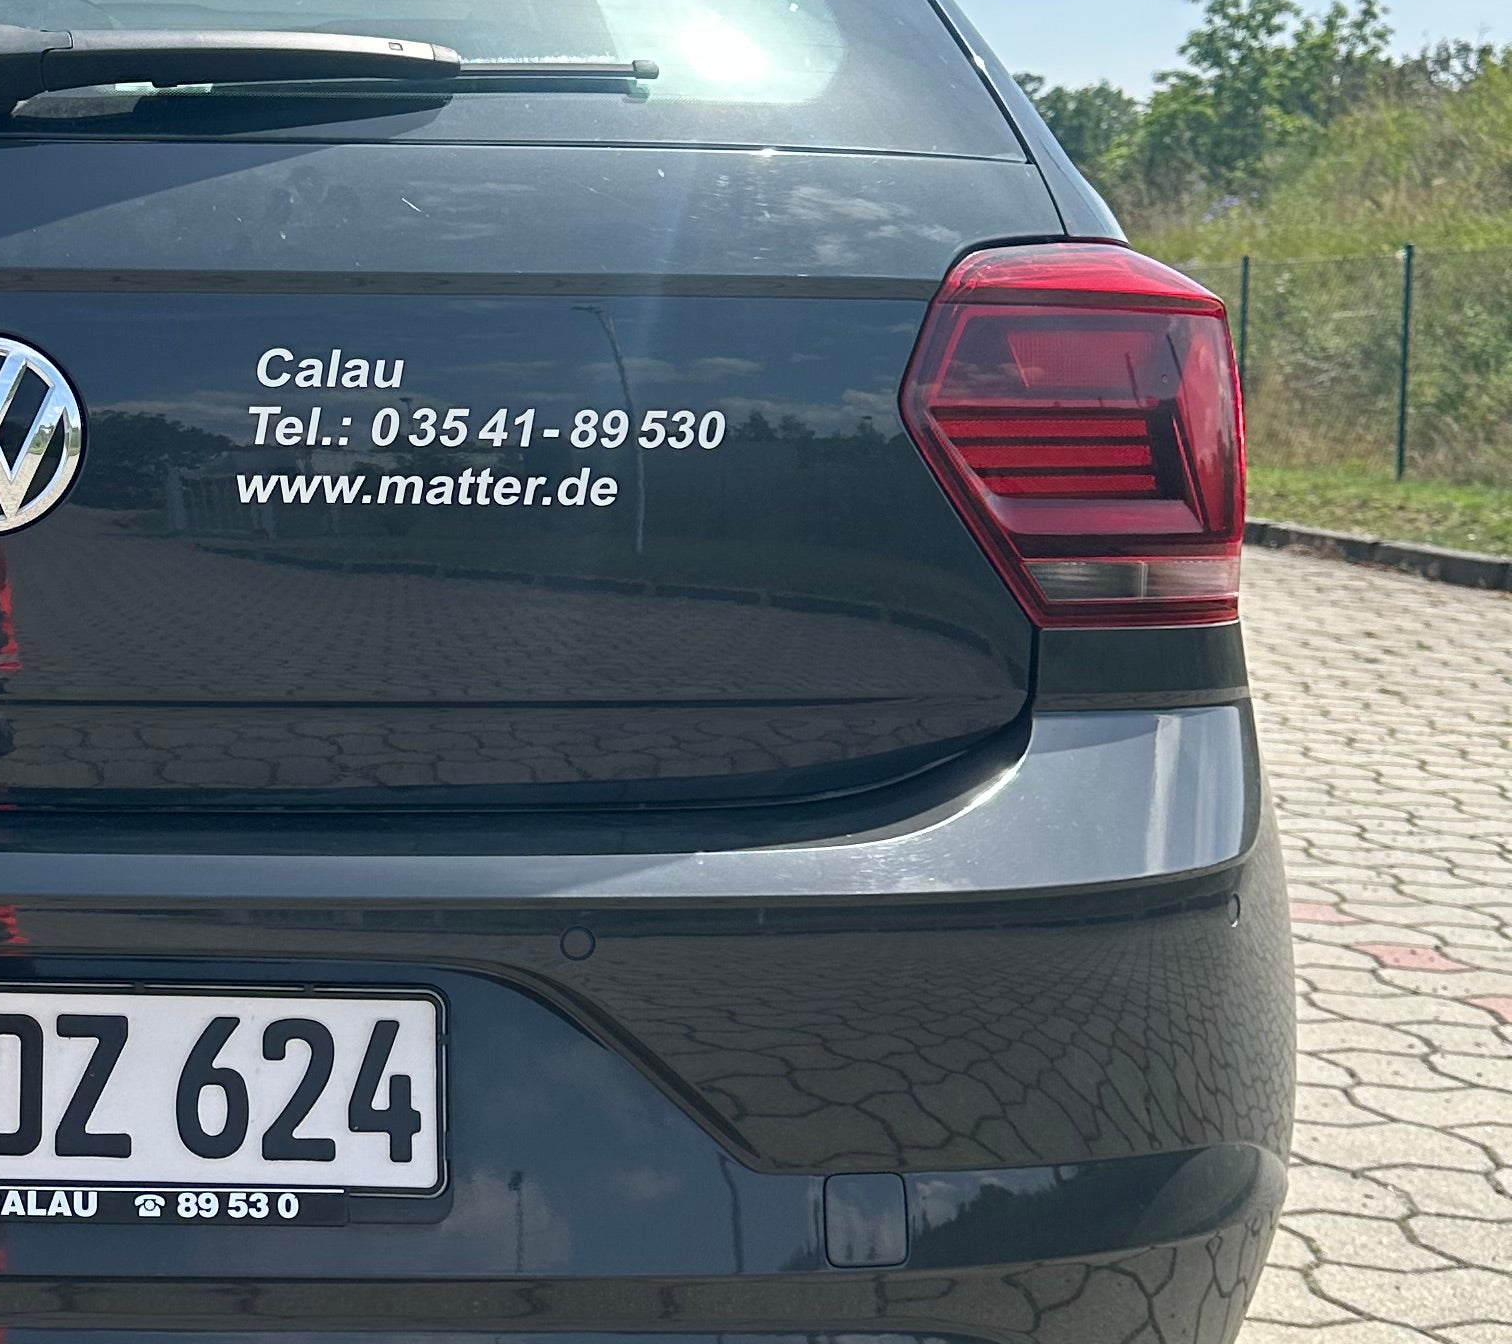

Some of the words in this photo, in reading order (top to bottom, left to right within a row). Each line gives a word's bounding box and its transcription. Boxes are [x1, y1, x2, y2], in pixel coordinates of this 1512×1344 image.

[256, 347, 405, 388] Calau
[247, 405, 352, 446] Tel.:
[236, 466, 619, 507] www.matter.de
[175, 1015, 422, 1163] 624
